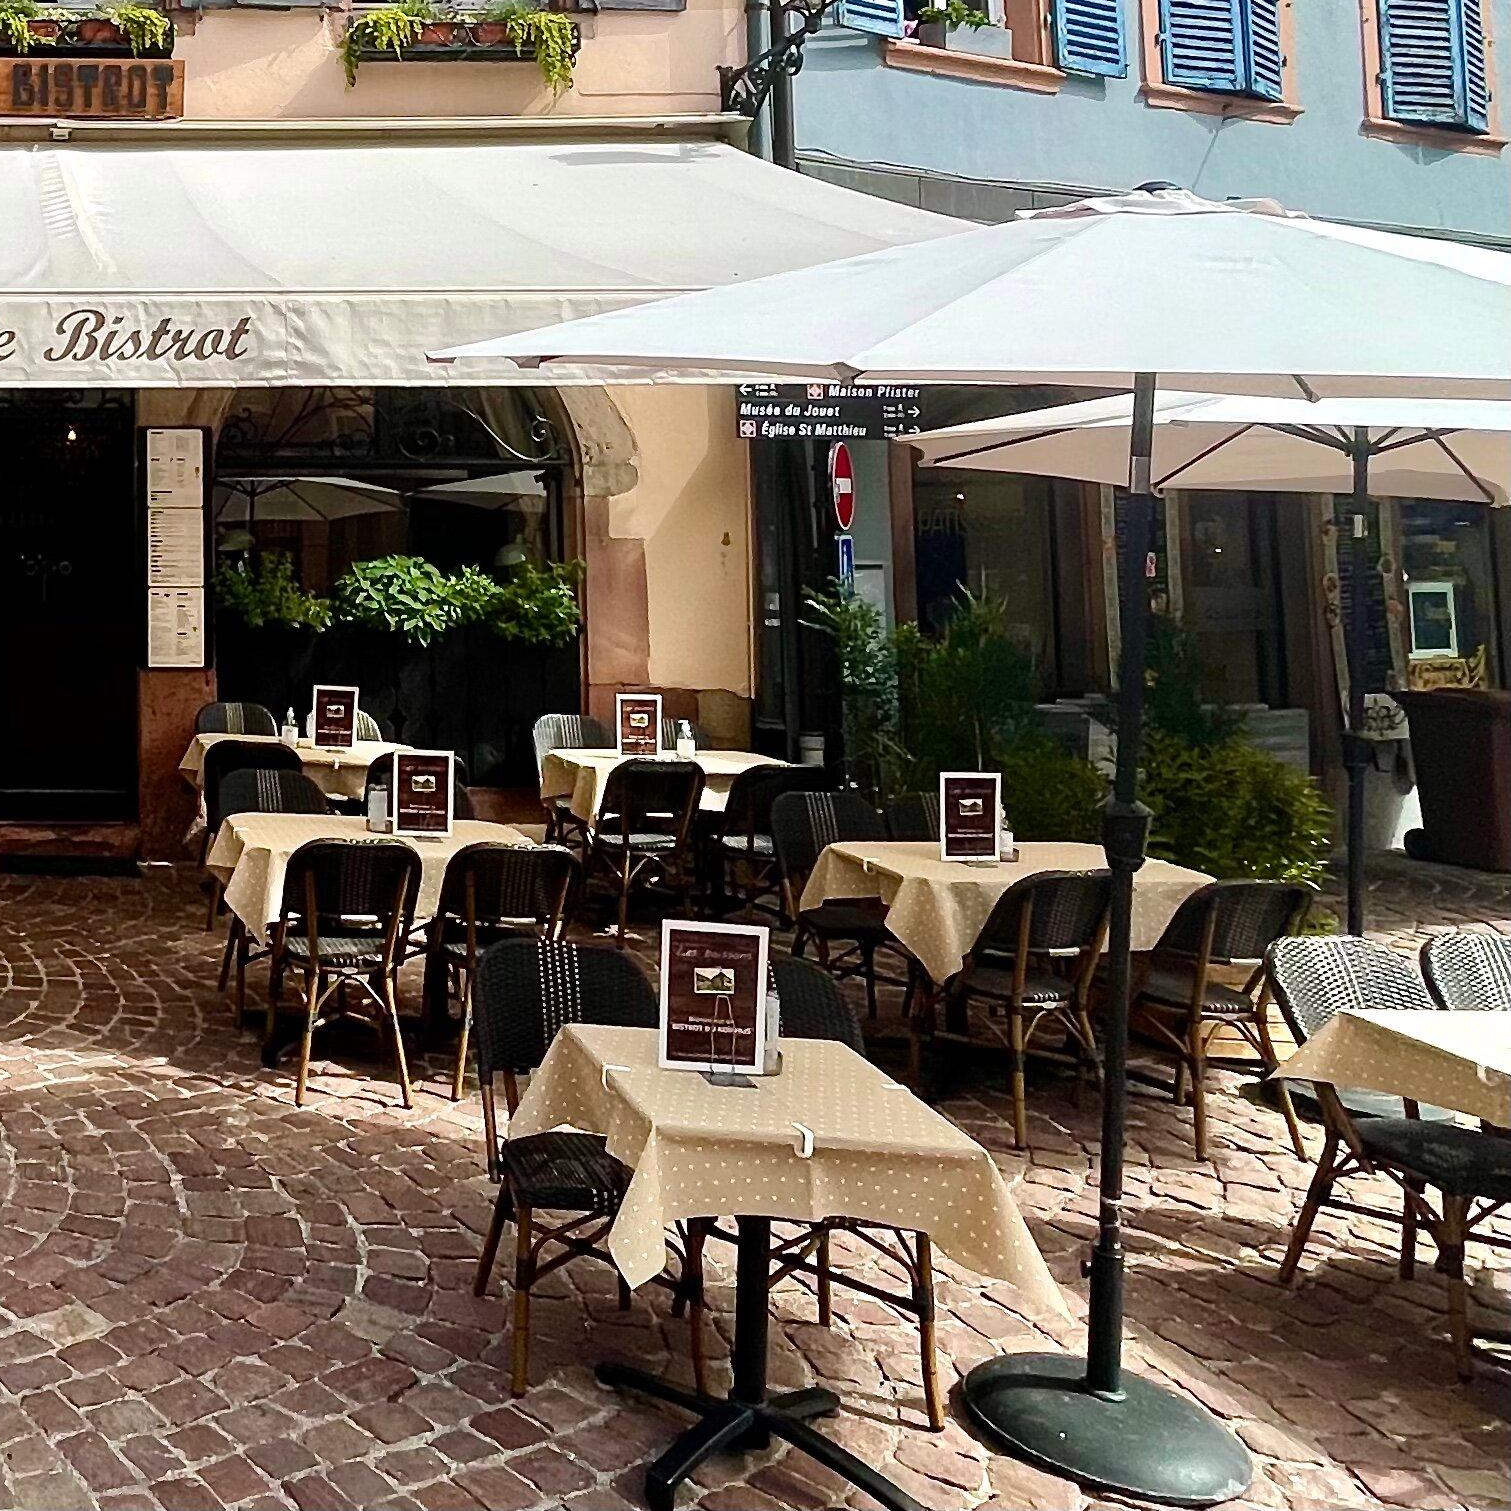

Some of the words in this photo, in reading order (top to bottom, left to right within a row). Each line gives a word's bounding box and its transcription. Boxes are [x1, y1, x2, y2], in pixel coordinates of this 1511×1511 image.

[12, 63, 176, 111] BISTROT
[42, 308, 253, 363] Bistrot
[828, 385, 873, 398] Maison
[876, 385, 921, 399] Pfister
[739, 402, 781, 416] Musée
[784, 403, 801, 416] du
[803, 404, 840, 417] Jouet
[761, 420, 796, 438] Église
[798, 423, 812, 436] St
[814, 422, 867, 437] Matthieu
